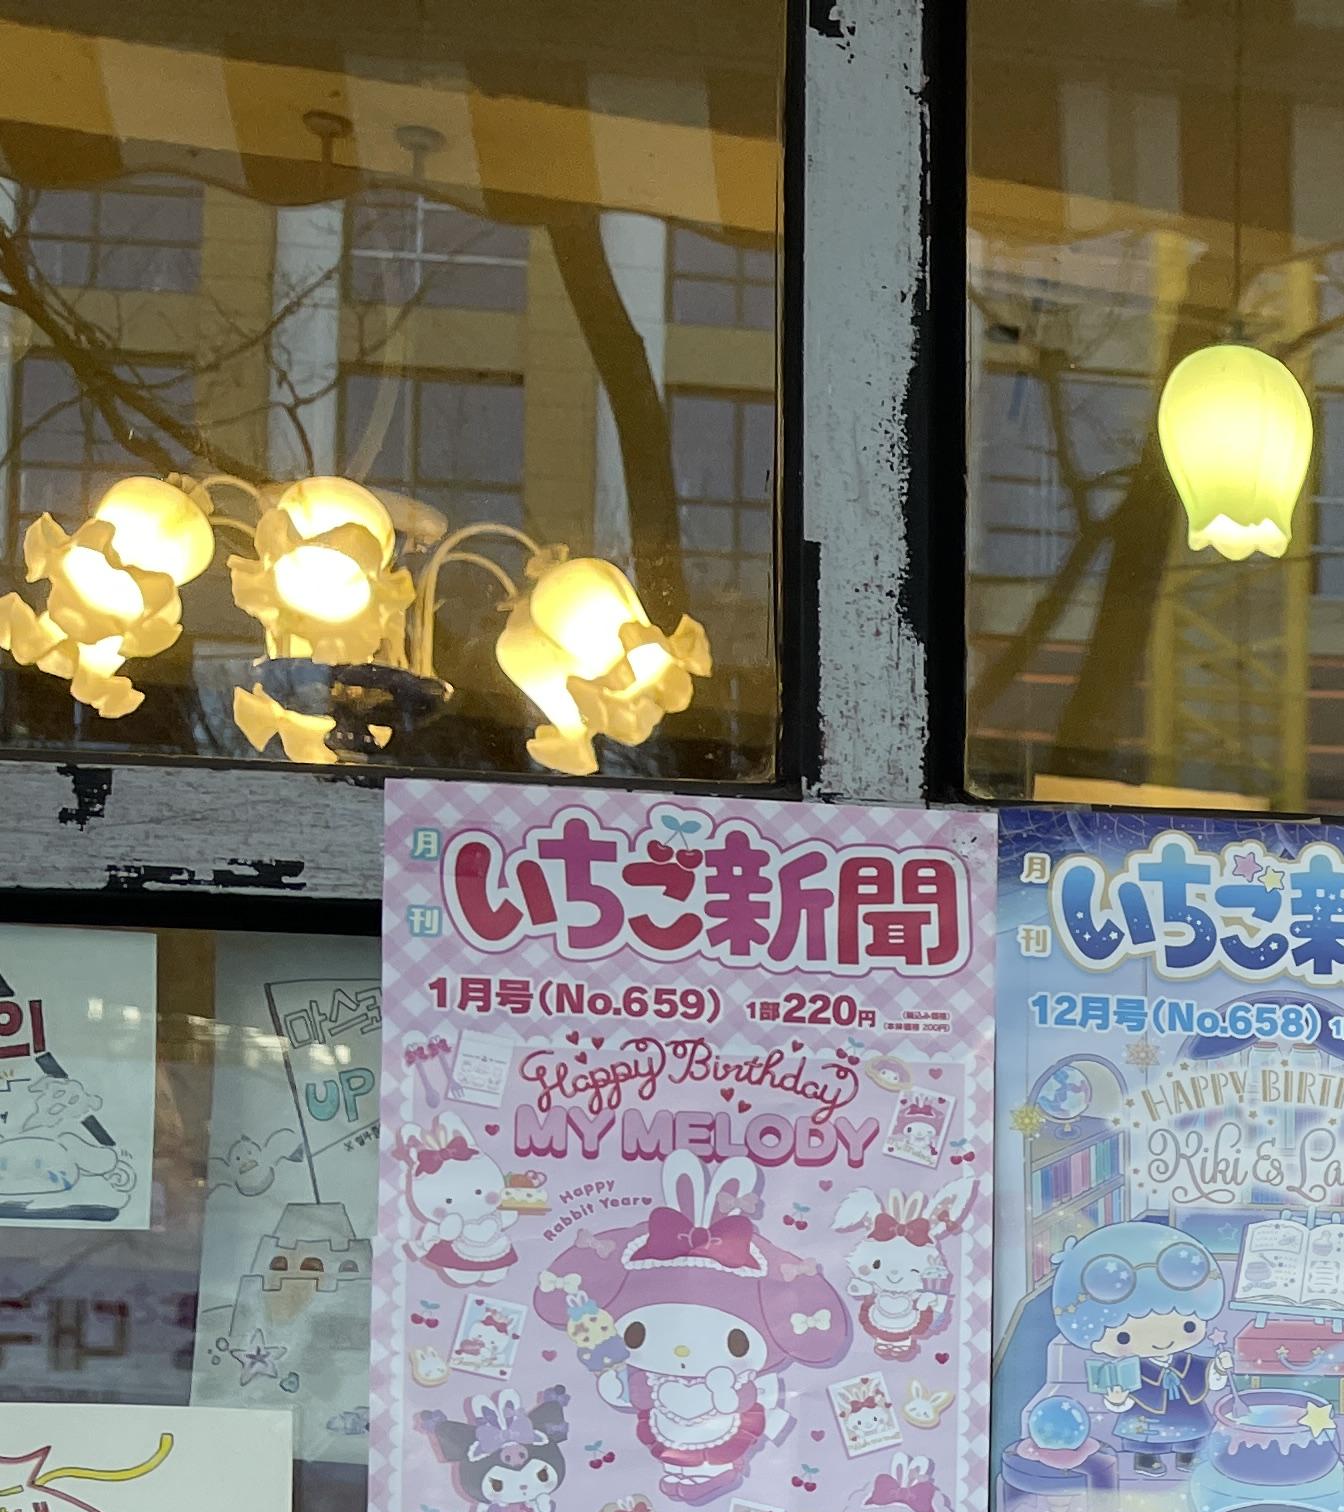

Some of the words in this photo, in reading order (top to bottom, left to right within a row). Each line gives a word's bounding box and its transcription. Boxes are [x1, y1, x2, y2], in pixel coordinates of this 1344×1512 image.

[453, 815, 963, 968] いちご新聞
[427, 976, 722, 1024] 1月号(No.659)
[745, 992, 877, 1029] 1部220円
[1030, 993, 1324, 1043] 12月号(No.658)
[305, 1067, 376, 1123] UP
[518, 1037, 667, 1115] Happy
[664, 1037, 862, 1124] Birthday
[1141, 1066, 1249, 1123] HAPPY
[514, 1105, 616, 1161] MY
[621, 1108, 881, 1169] MELODY
[1146, 1120, 1250, 1205] Kiki
[543, 1202, 595, 1242] Rabbit
[599, 1196, 643, 1210] Year
[559, 1179, 616, 1204] Happy
